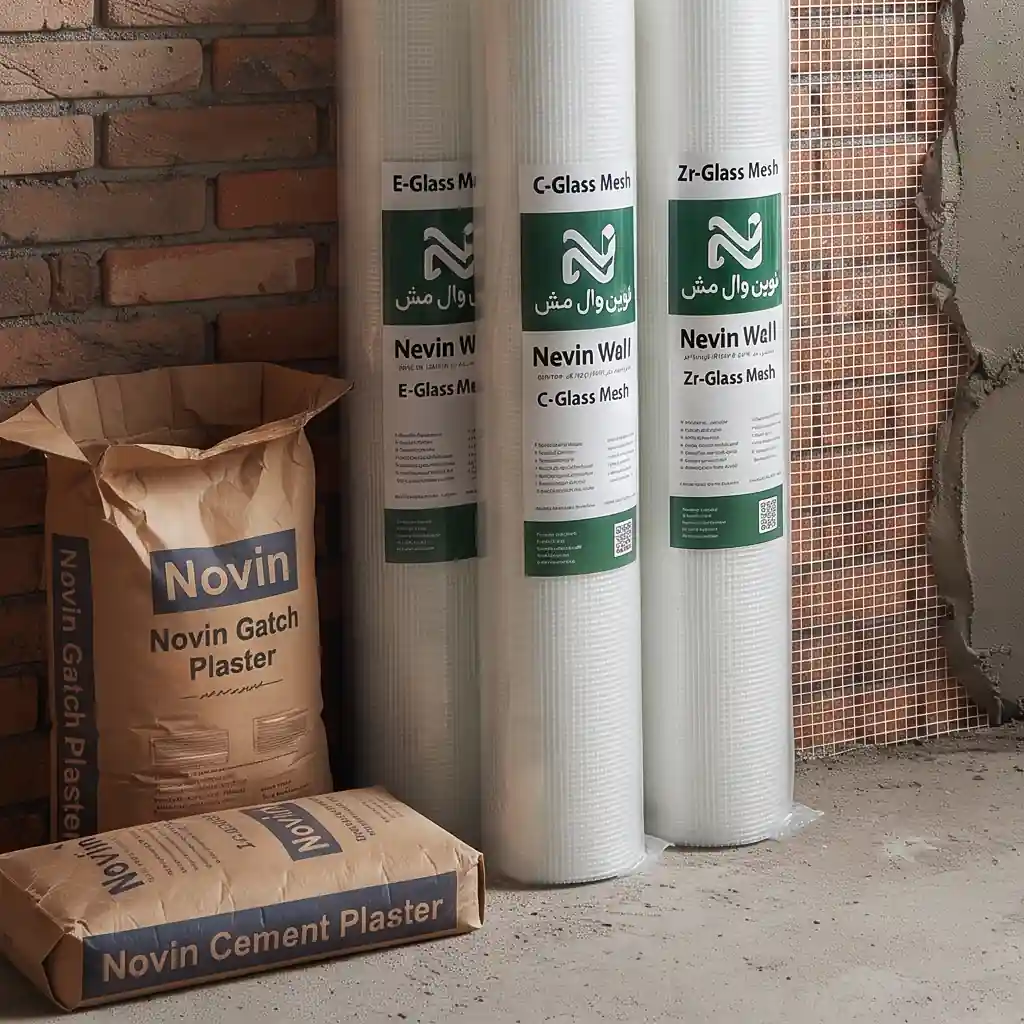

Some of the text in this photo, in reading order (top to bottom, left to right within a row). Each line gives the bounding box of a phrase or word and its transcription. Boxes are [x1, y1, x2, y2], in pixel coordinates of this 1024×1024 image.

[393, 173, 455, 193] E-Glass
[533, 171, 631, 194] C-Glass Mesh
[677, 159, 779, 183] Zr-Glass Mesh
[395, 287, 433, 311] مش
[437, 285, 466, 310] وال
[681, 276, 718, 300] مش
[722, 274, 749, 301] وال
[534, 291, 573, 316] مش
[576, 288, 604, 315] وال
[680, 320, 777, 350] Nevin Wall
[394, 337, 455, 359] Nevin
[533, 337, 631, 367] Nevin Wall
[683, 364, 776, 386] Zr-Glass Mesh
[398, 381, 454, 398] E-Glass
[537, 383, 629, 408] C-Glass Mesh
[164, 546, 290, 602] Novin
[59, 548, 82, 632] Novin
[150, 606, 299, 653] Novin Gatch
[189, 647, 277, 680] Plaster
[62, 642, 86, 728] Gatch
[103, 898, 443, 982] Novin Cement Plaster
